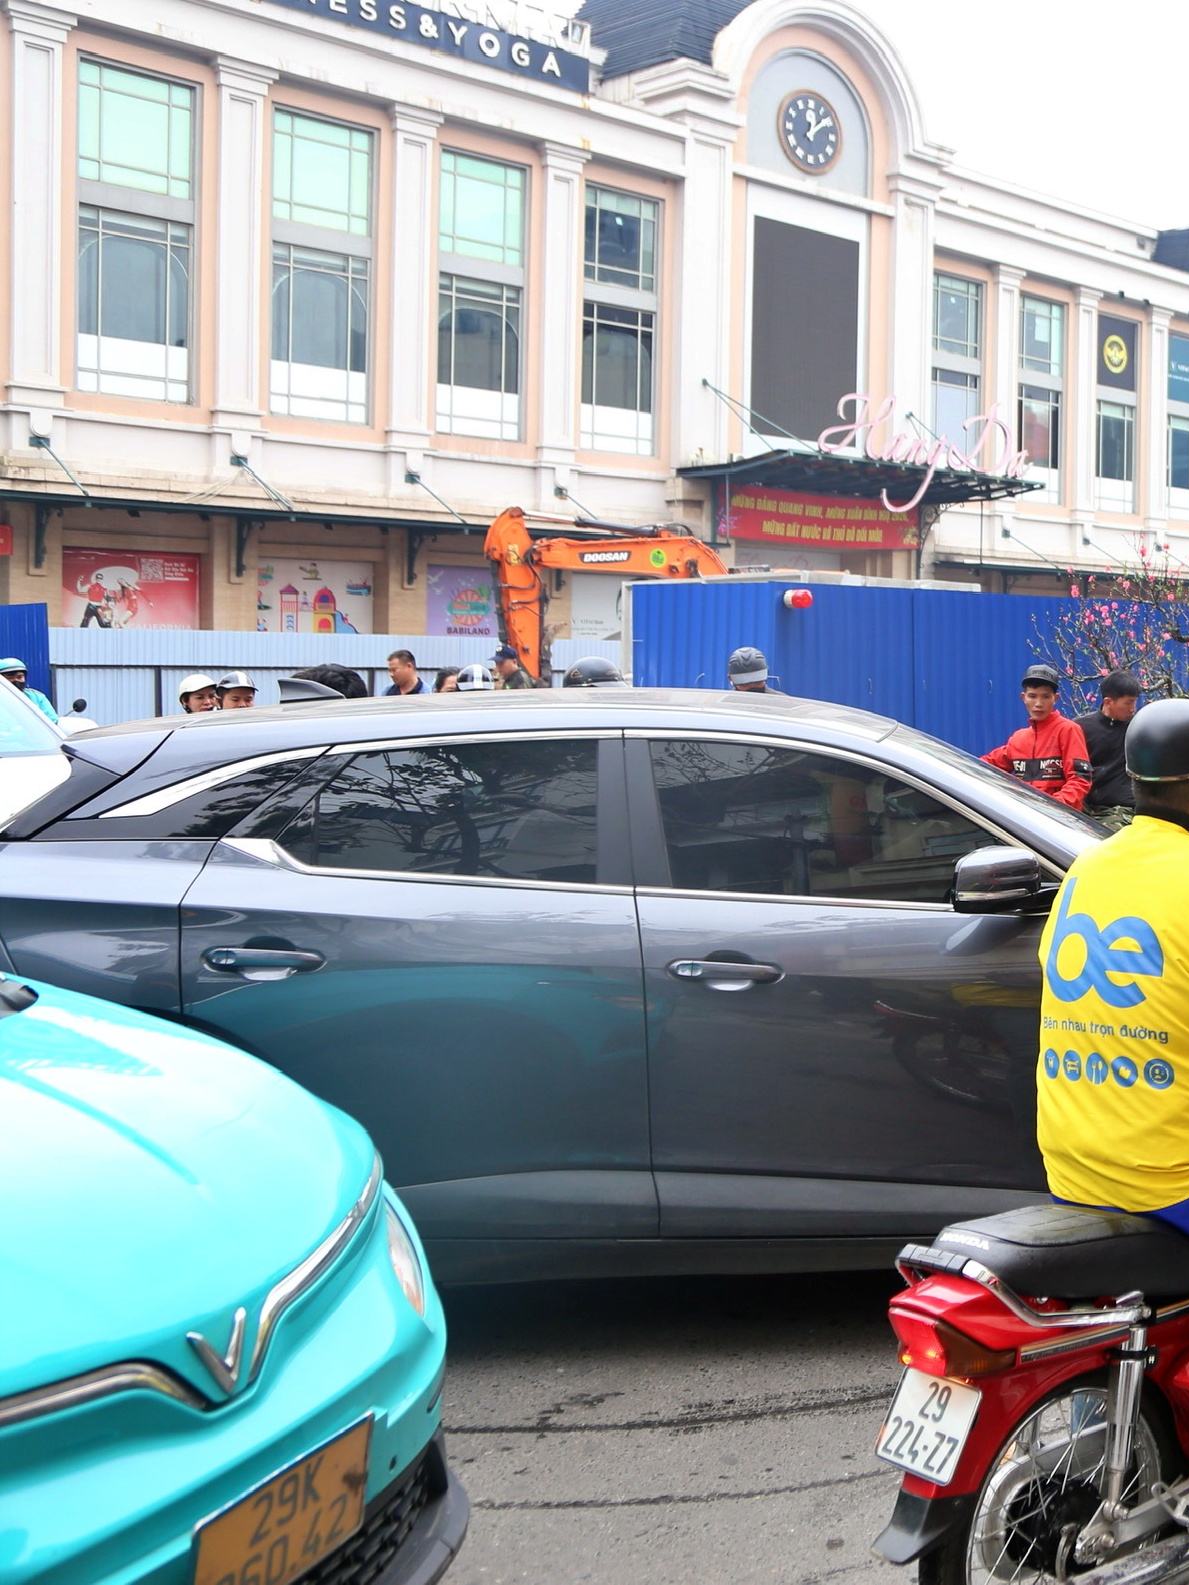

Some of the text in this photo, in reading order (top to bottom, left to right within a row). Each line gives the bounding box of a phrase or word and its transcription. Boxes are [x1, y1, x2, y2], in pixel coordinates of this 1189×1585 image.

[302, 0, 561, 77] ESS&YOGA
[778, 500, 803, 516] QUANG
[583, 551, 628, 563] DOOSAN
[447, 627, 490, 635] BABILAND
[1046, 878, 1164, 1008] be
[1043, 1016, 1169, 1044] Bên nhau trọn đường
[939, 1232, 990, 1251] HONDA
[918, 1381, 952, 1423] 29
[249, 1454, 326, 1547] 29K
[217, 1493, 348, 1585] 60.42
